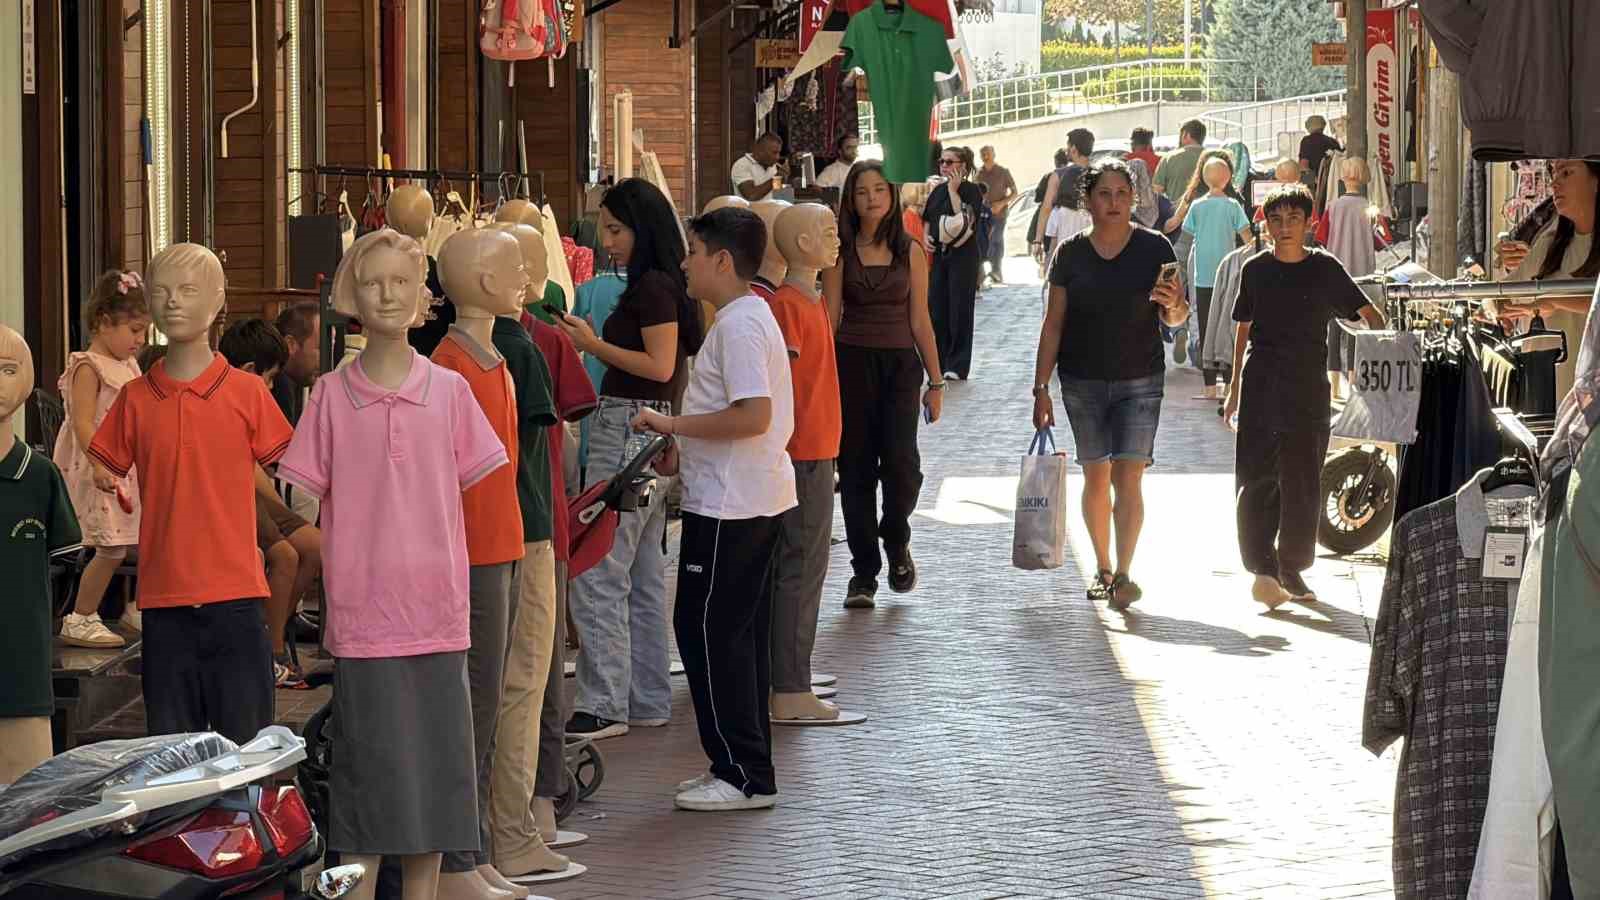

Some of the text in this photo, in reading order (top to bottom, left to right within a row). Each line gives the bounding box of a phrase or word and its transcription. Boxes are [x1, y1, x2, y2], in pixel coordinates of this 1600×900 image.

[1373, 59, 1393, 128] Giyim
[1360, 360, 1414, 392] 350 TL
